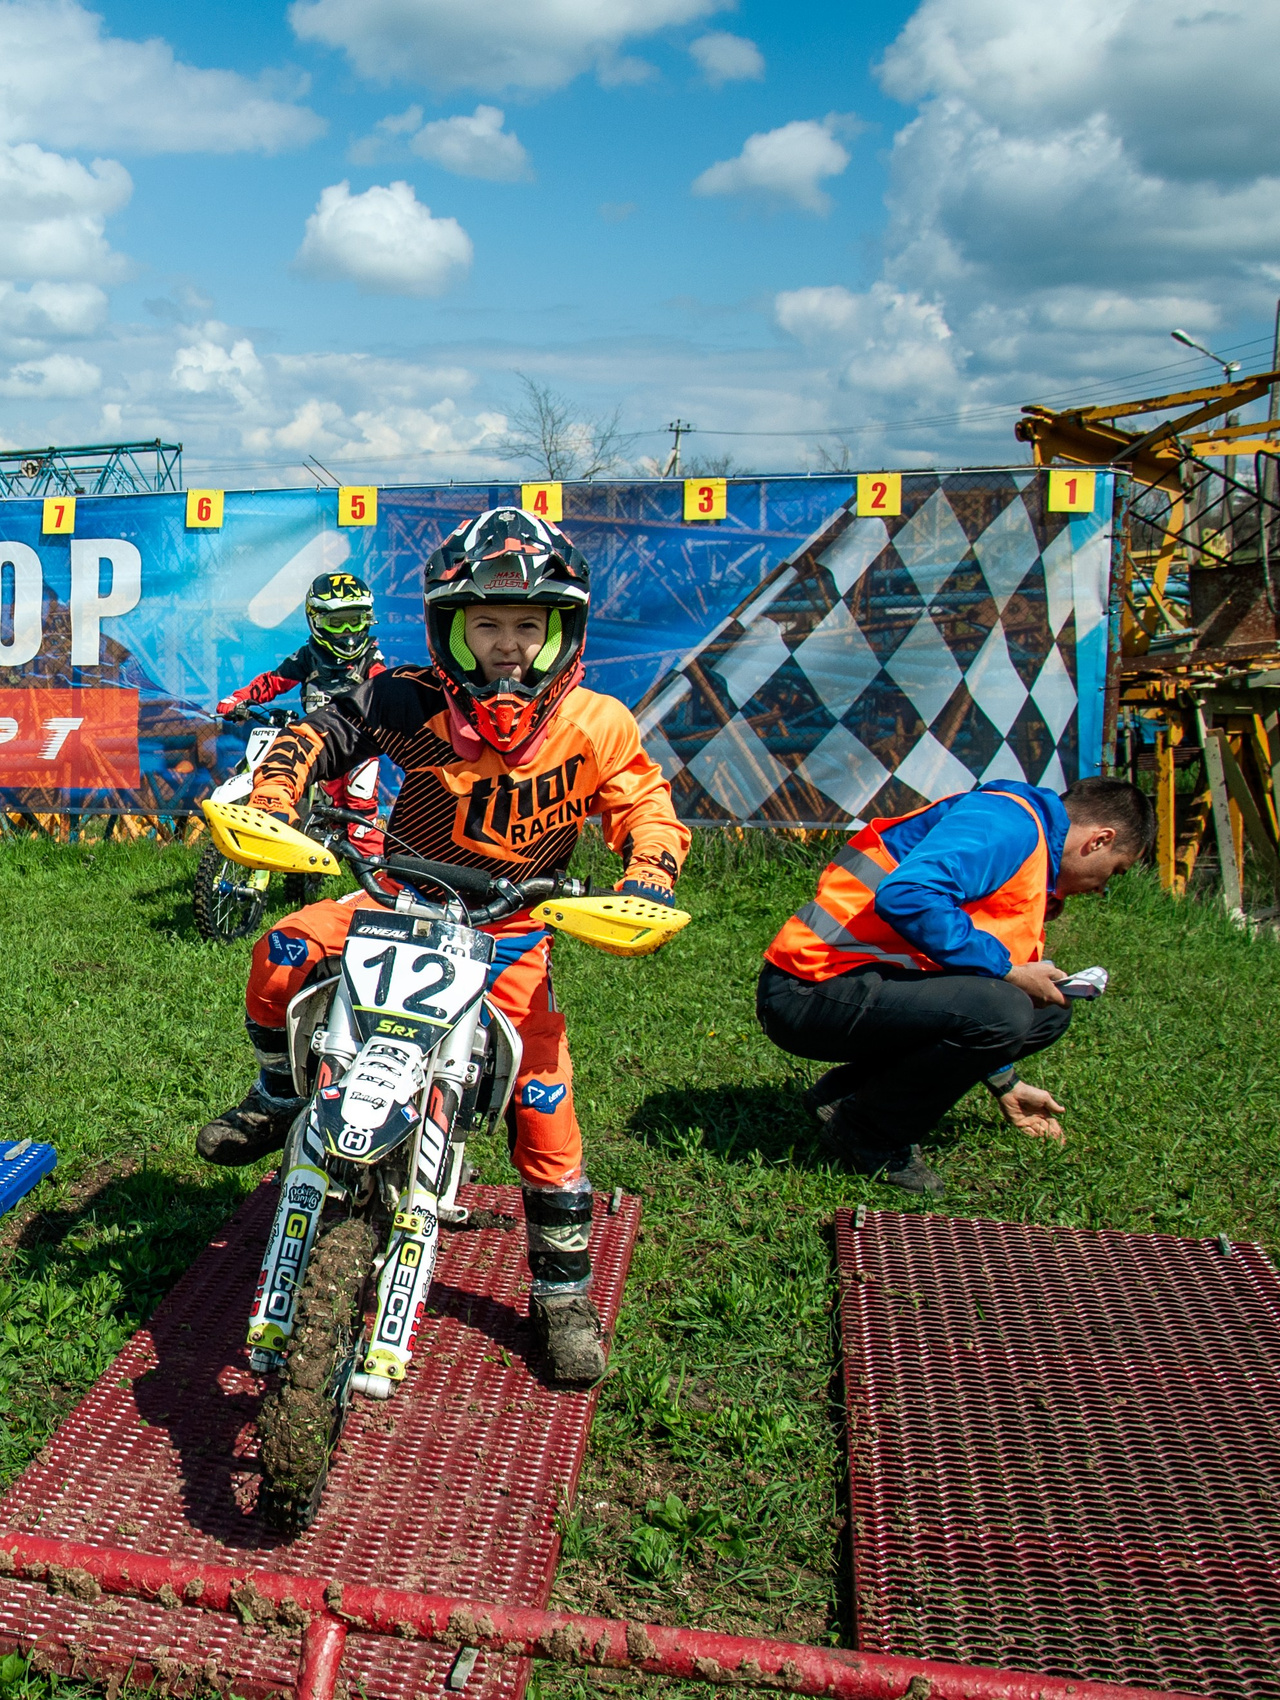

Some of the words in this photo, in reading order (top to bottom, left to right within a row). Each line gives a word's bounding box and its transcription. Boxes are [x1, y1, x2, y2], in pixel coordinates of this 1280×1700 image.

[533, 490, 549, 515] 4
[698, 487, 714, 512] 3
[871, 481, 887, 509] 2
[1065, 478, 1077, 505] 1
[54, 505, 65, 528] 7
[197, 497, 212, 522] 6
[350, 495, 366, 520] 5
[328, 574, 356, 587] 72
[363, 945, 456, 1020] 12
[375, 1018, 420, 1039] SRX
[268, 1212, 308, 1317] GEICO
[381, 1241, 422, 1342] GEICO
